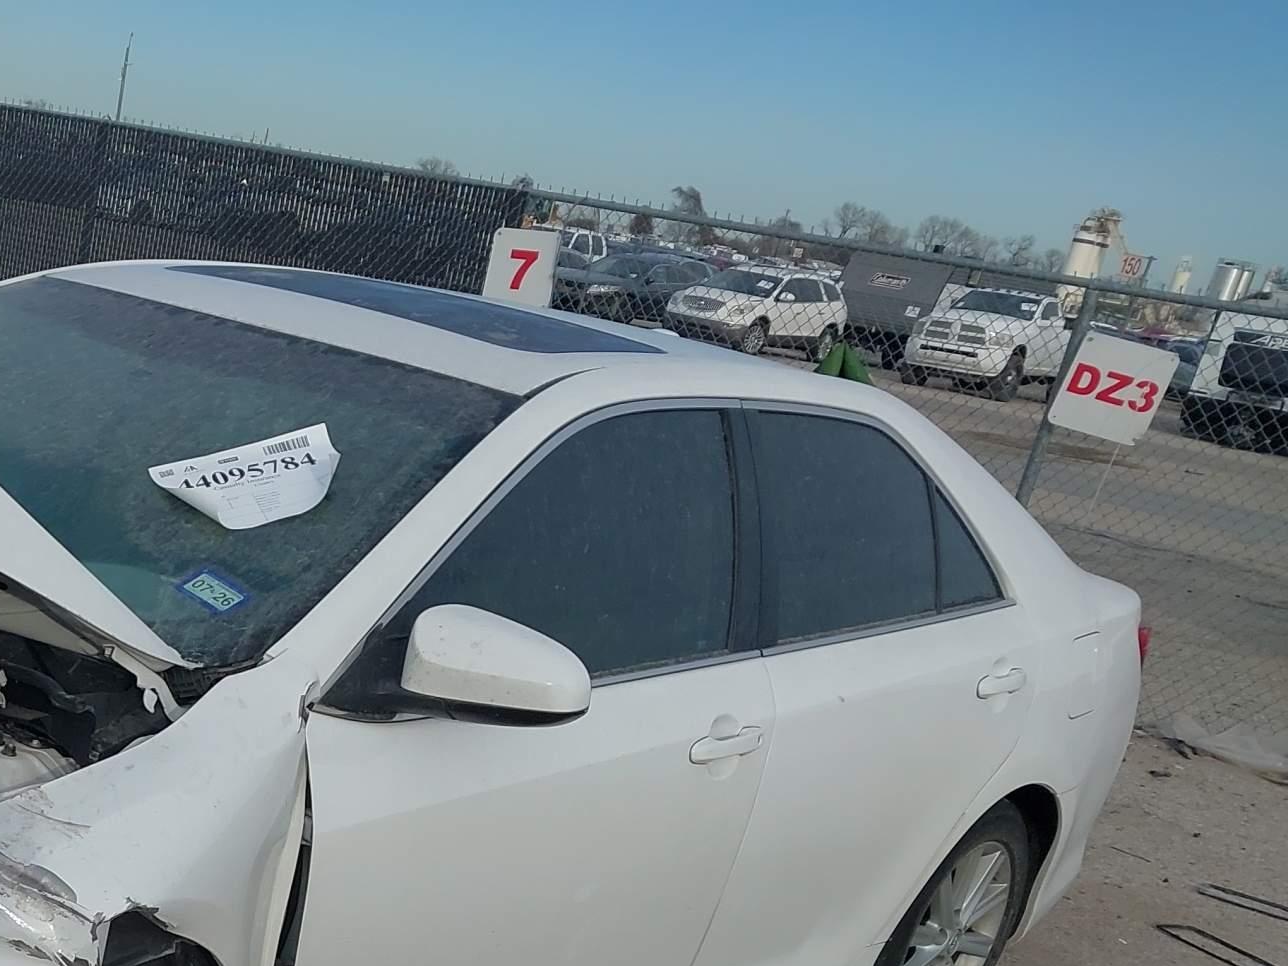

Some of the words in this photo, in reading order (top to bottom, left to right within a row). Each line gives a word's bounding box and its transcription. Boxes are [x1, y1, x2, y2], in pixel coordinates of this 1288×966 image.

[509, 248, 540, 290] 7
[1120, 256, 1143, 276] 150
[1066, 362, 1160, 413] DZ3
[179, 452, 318, 489] 44095784
[191, 579, 213, 593] 07
[211, 592, 236, 607] 26
